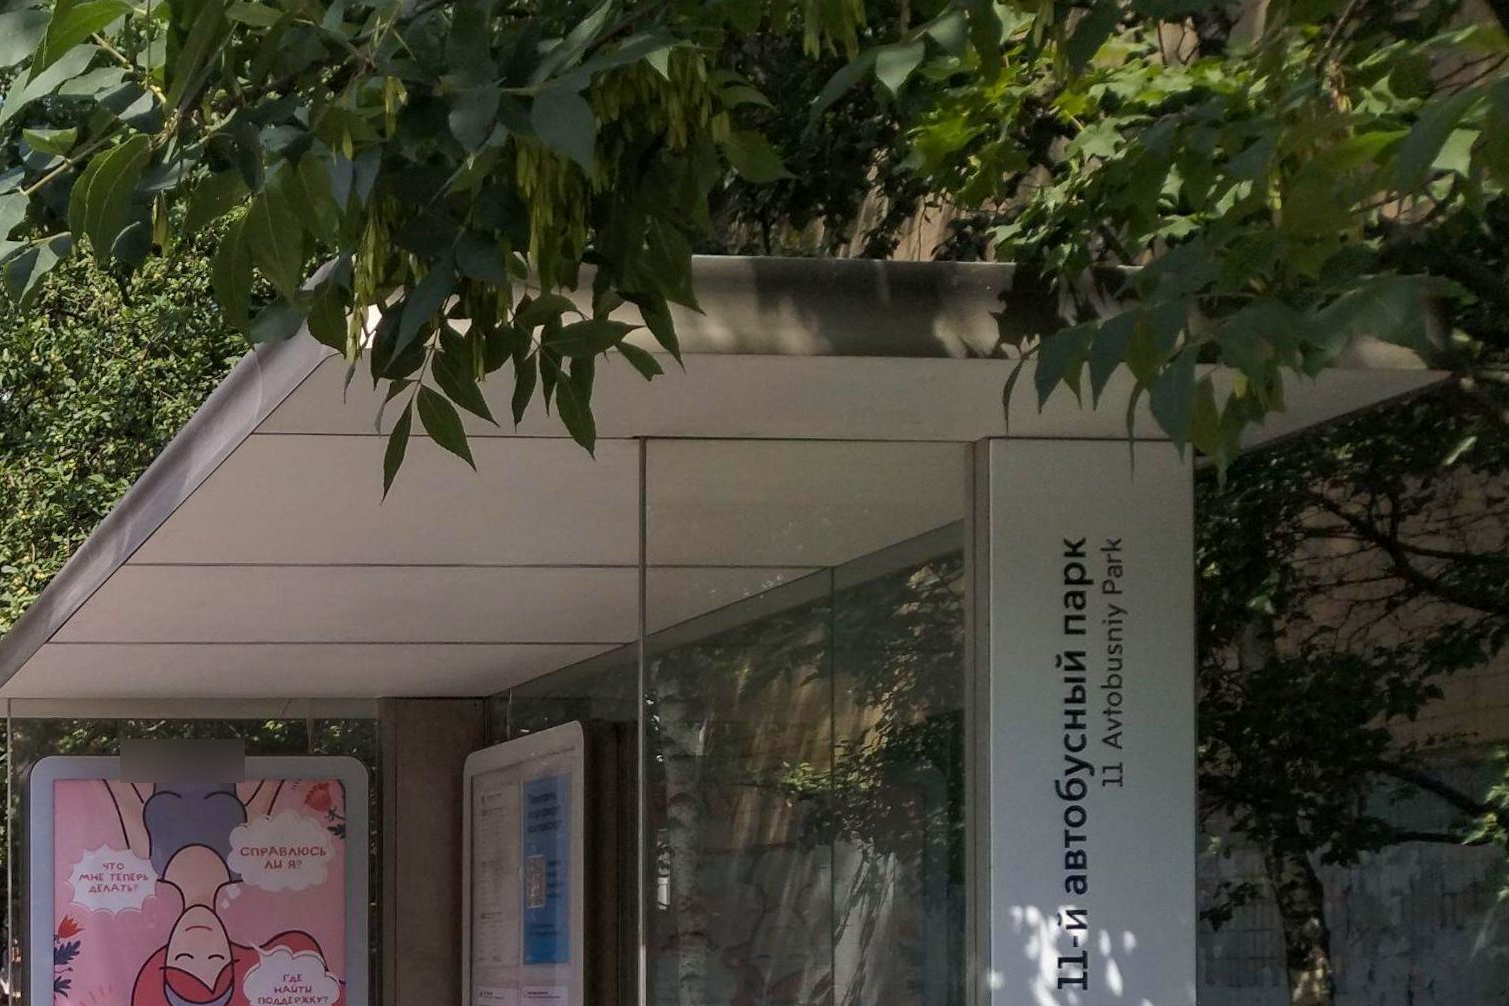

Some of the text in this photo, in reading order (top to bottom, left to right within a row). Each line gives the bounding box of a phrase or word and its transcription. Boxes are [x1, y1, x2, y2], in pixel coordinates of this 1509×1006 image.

[1101, 537, 1127, 788] 11 Avtobusniy Park
[1054, 537, 1094, 991] 11-й автобусный парк
[240, 846, 327, 857] СПРАВЛЮСЬ
[102, 862, 125, 870] ЧТО
[264, 859, 303, 869] ЛИ Я?
[79, 872, 149, 881] МНЕ ТЕПЕРЬ
[88, 884, 139, 893] ДЕЛАТЬ?
[283, 974, 303, 983] ГДЕ
[258, 996, 329, 1005] ПОДДЕРЖКУ?
